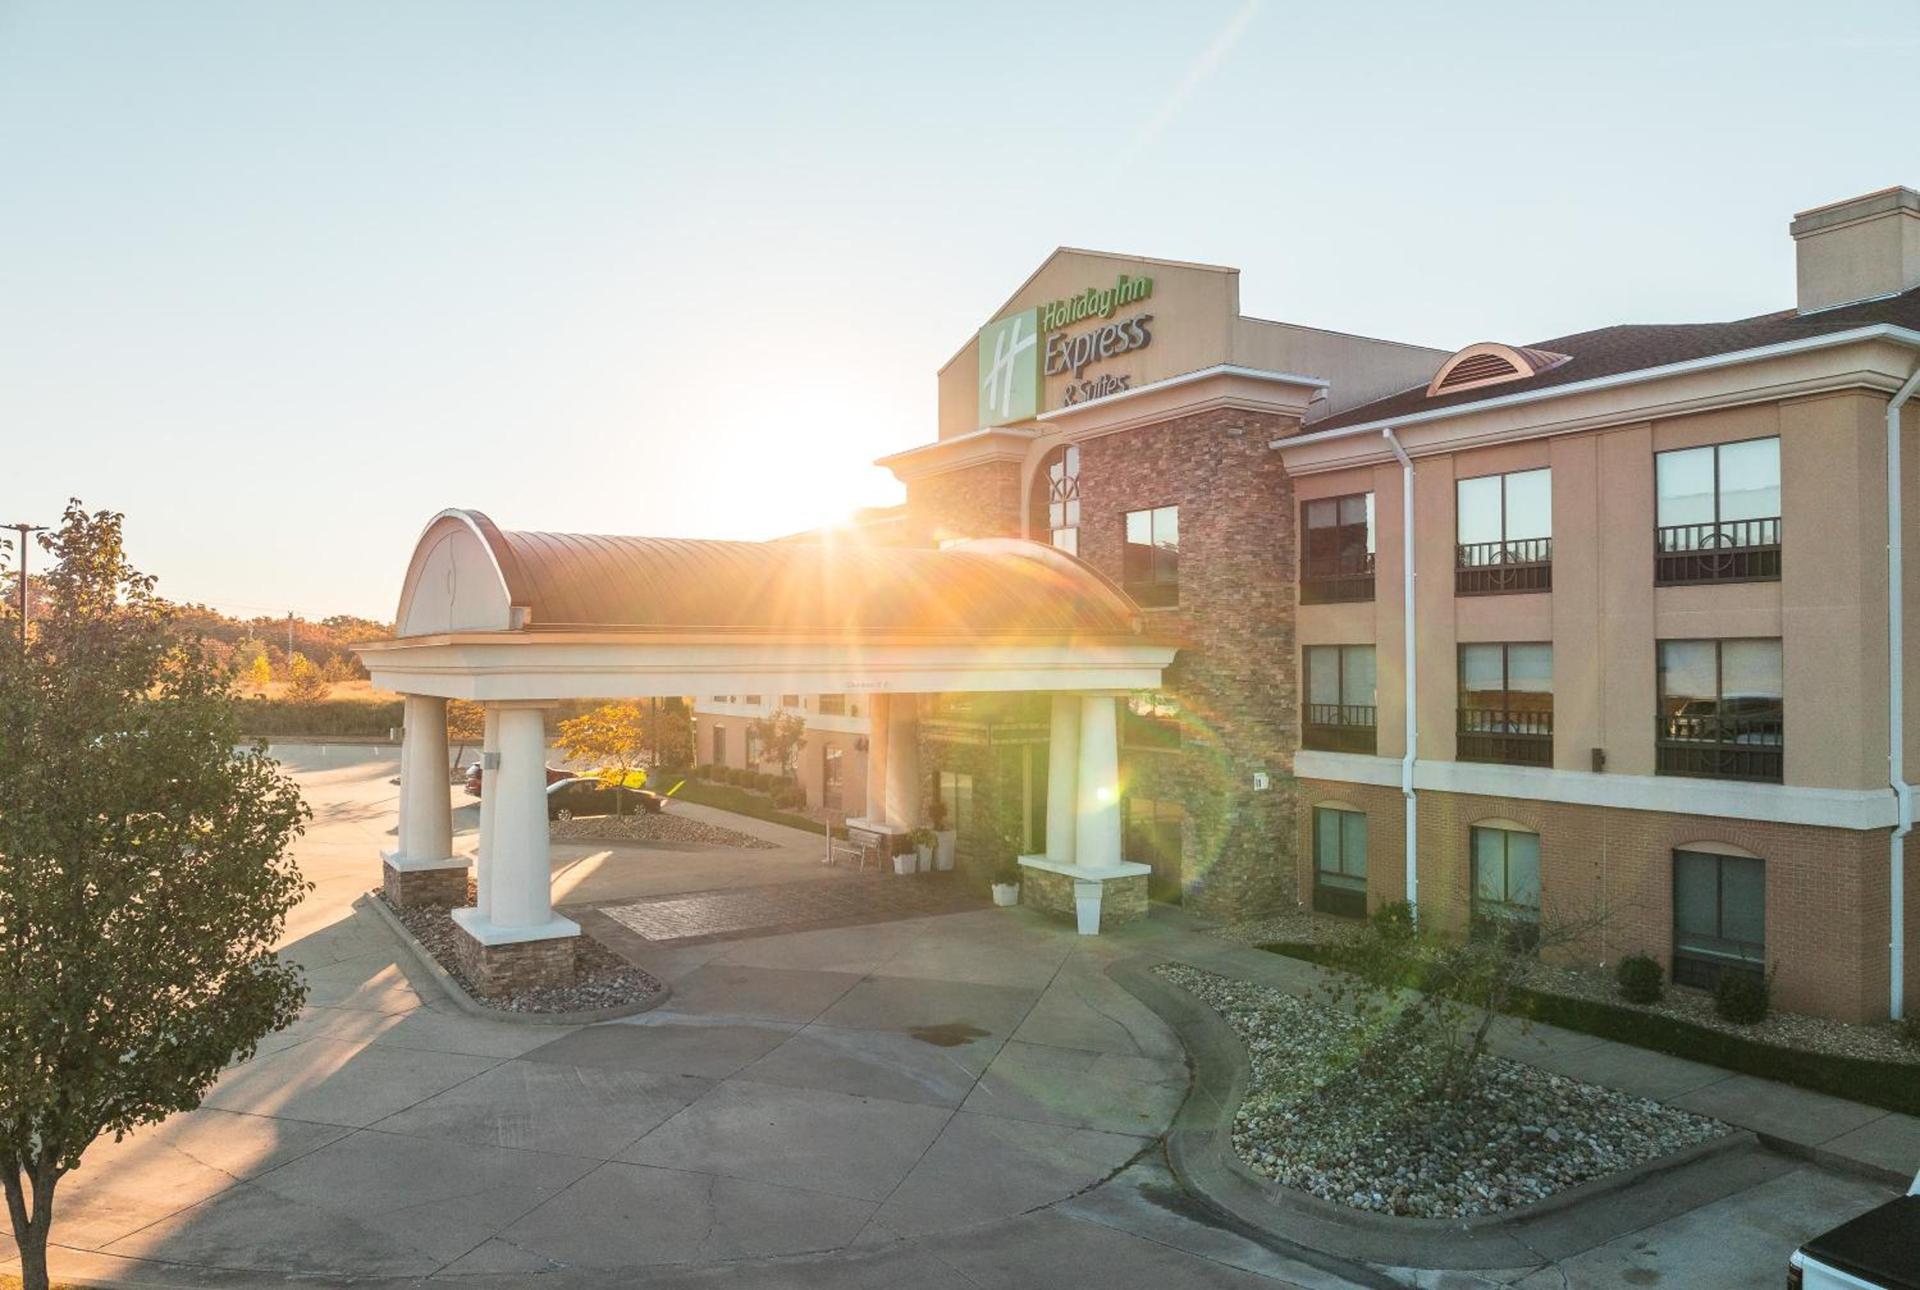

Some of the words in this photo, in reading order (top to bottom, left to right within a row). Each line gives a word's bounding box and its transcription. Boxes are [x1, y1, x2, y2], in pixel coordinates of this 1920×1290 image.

[1043, 288, 1115, 332] Holiday
[1114, 273, 1151, 305] Inn
[1044, 313, 1153, 378] Express
[1064, 383, 1077, 407] &
[1080, 374, 1130, 401] Suites
